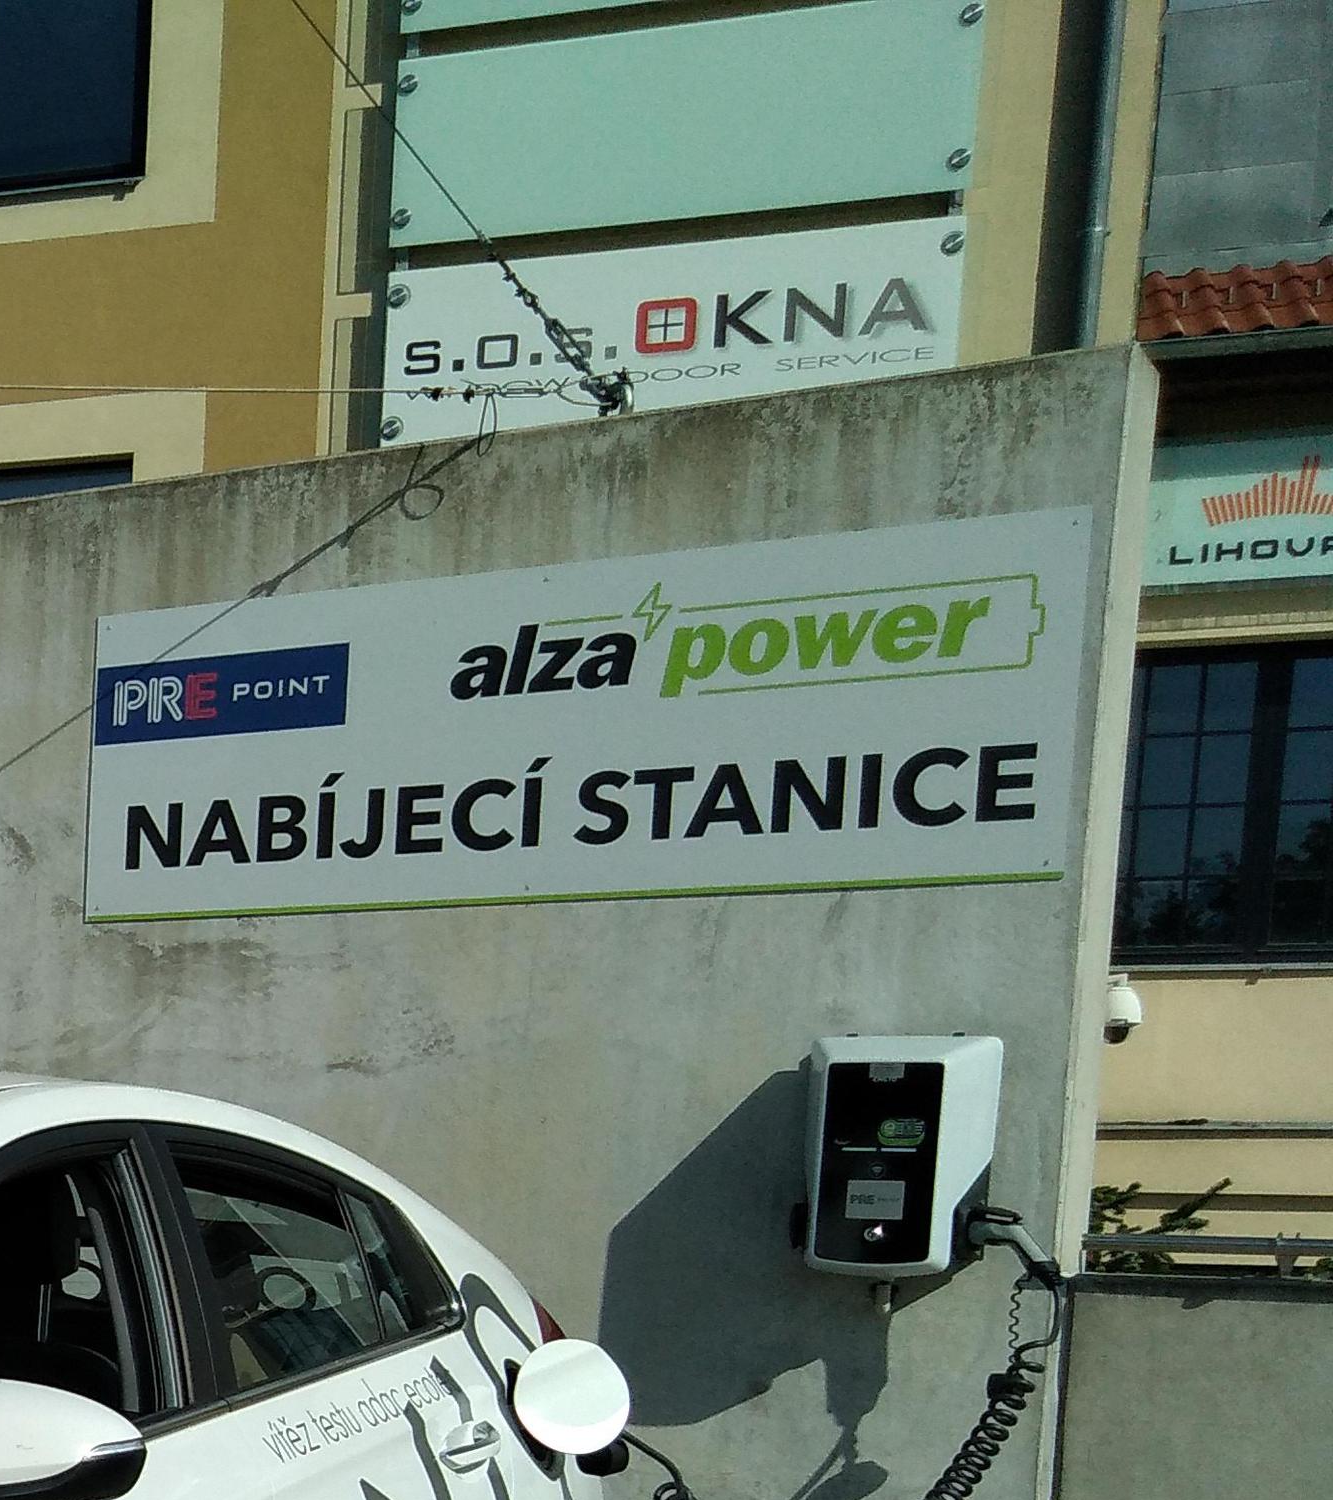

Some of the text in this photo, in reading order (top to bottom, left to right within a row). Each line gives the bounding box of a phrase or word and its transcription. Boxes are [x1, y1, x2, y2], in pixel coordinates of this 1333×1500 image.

[635, 278, 928, 353] OKNA
[775, 346, 933, 373] SERVICE
[112, 672, 330, 727] PRE POINT
[124, 742, 1038, 871] NABÍJECÍ STANICE
[306, 1402, 363, 1445] testu
[357, 1378, 407, 1427] adac
